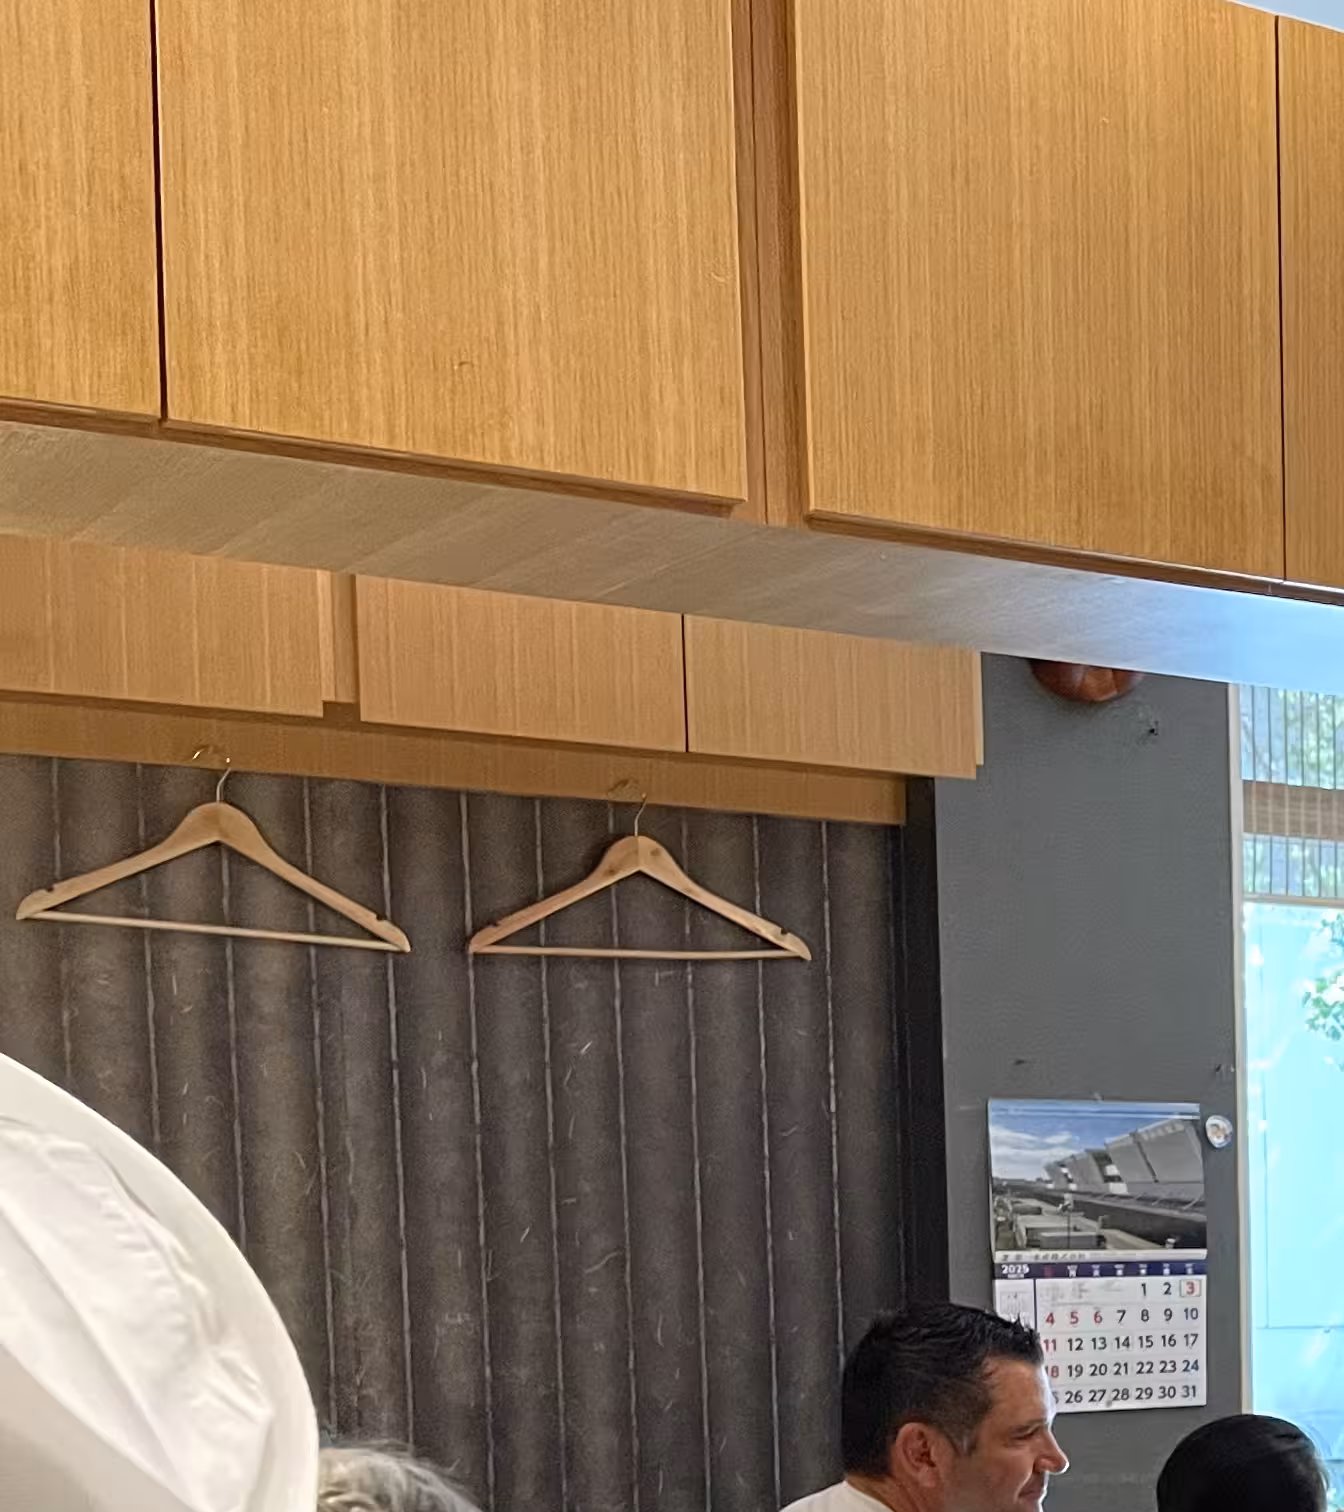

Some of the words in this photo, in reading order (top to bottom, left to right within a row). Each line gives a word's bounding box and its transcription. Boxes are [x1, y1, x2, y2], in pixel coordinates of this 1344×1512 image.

[1002, 1265, 1029, 1274] 2025
[1142, 1283, 1147, 1296] 1
[1163, 1283, 1171, 1295] 2
[1186, 1282, 1194, 1294] 3
[1046, 1313, 1055, 1325] 4
[1070, 1312, 1078, 1324] 5
[1094, 1311, 1102, 1324] 6
[1117, 1310, 1126, 1323] 7
[1141, 1309, 1149, 1321] 8
[1164, 1309, 1172, 1321] 9
[1184, 1308, 1198, 1320] 10
[1044, 1339, 1057, 1352] 11
[1068, 1338, 1083, 1351] 12
[1092, 1337, 1107, 1350] 13
[1115, 1336, 1130, 1349] 14
[1138, 1336, 1153, 1348] 15
[1162, 1334, 1176, 1347] 16
[1184, 1334, 1198, 1347] 17
[1068, 1365, 1083, 1377] 19
[1089, 1364, 1107, 1376] 20
[1114, 1363, 1128, 1375] 21
[1136, 1362, 1153, 1374] 22
[1159, 1361, 1176, 1373] 23
[1183, 1359, 1199, 1372] 24
[1065, 1391, 1083, 1404] 26
[1088, 1390, 1105, 1402] 27
[1112, 1388, 1129, 1400] 28
[1135, 1387, 1153, 1399] 29
[1158, 1386, 1176, 1398] 30
[1182, 1385, 1196, 1398] 31
